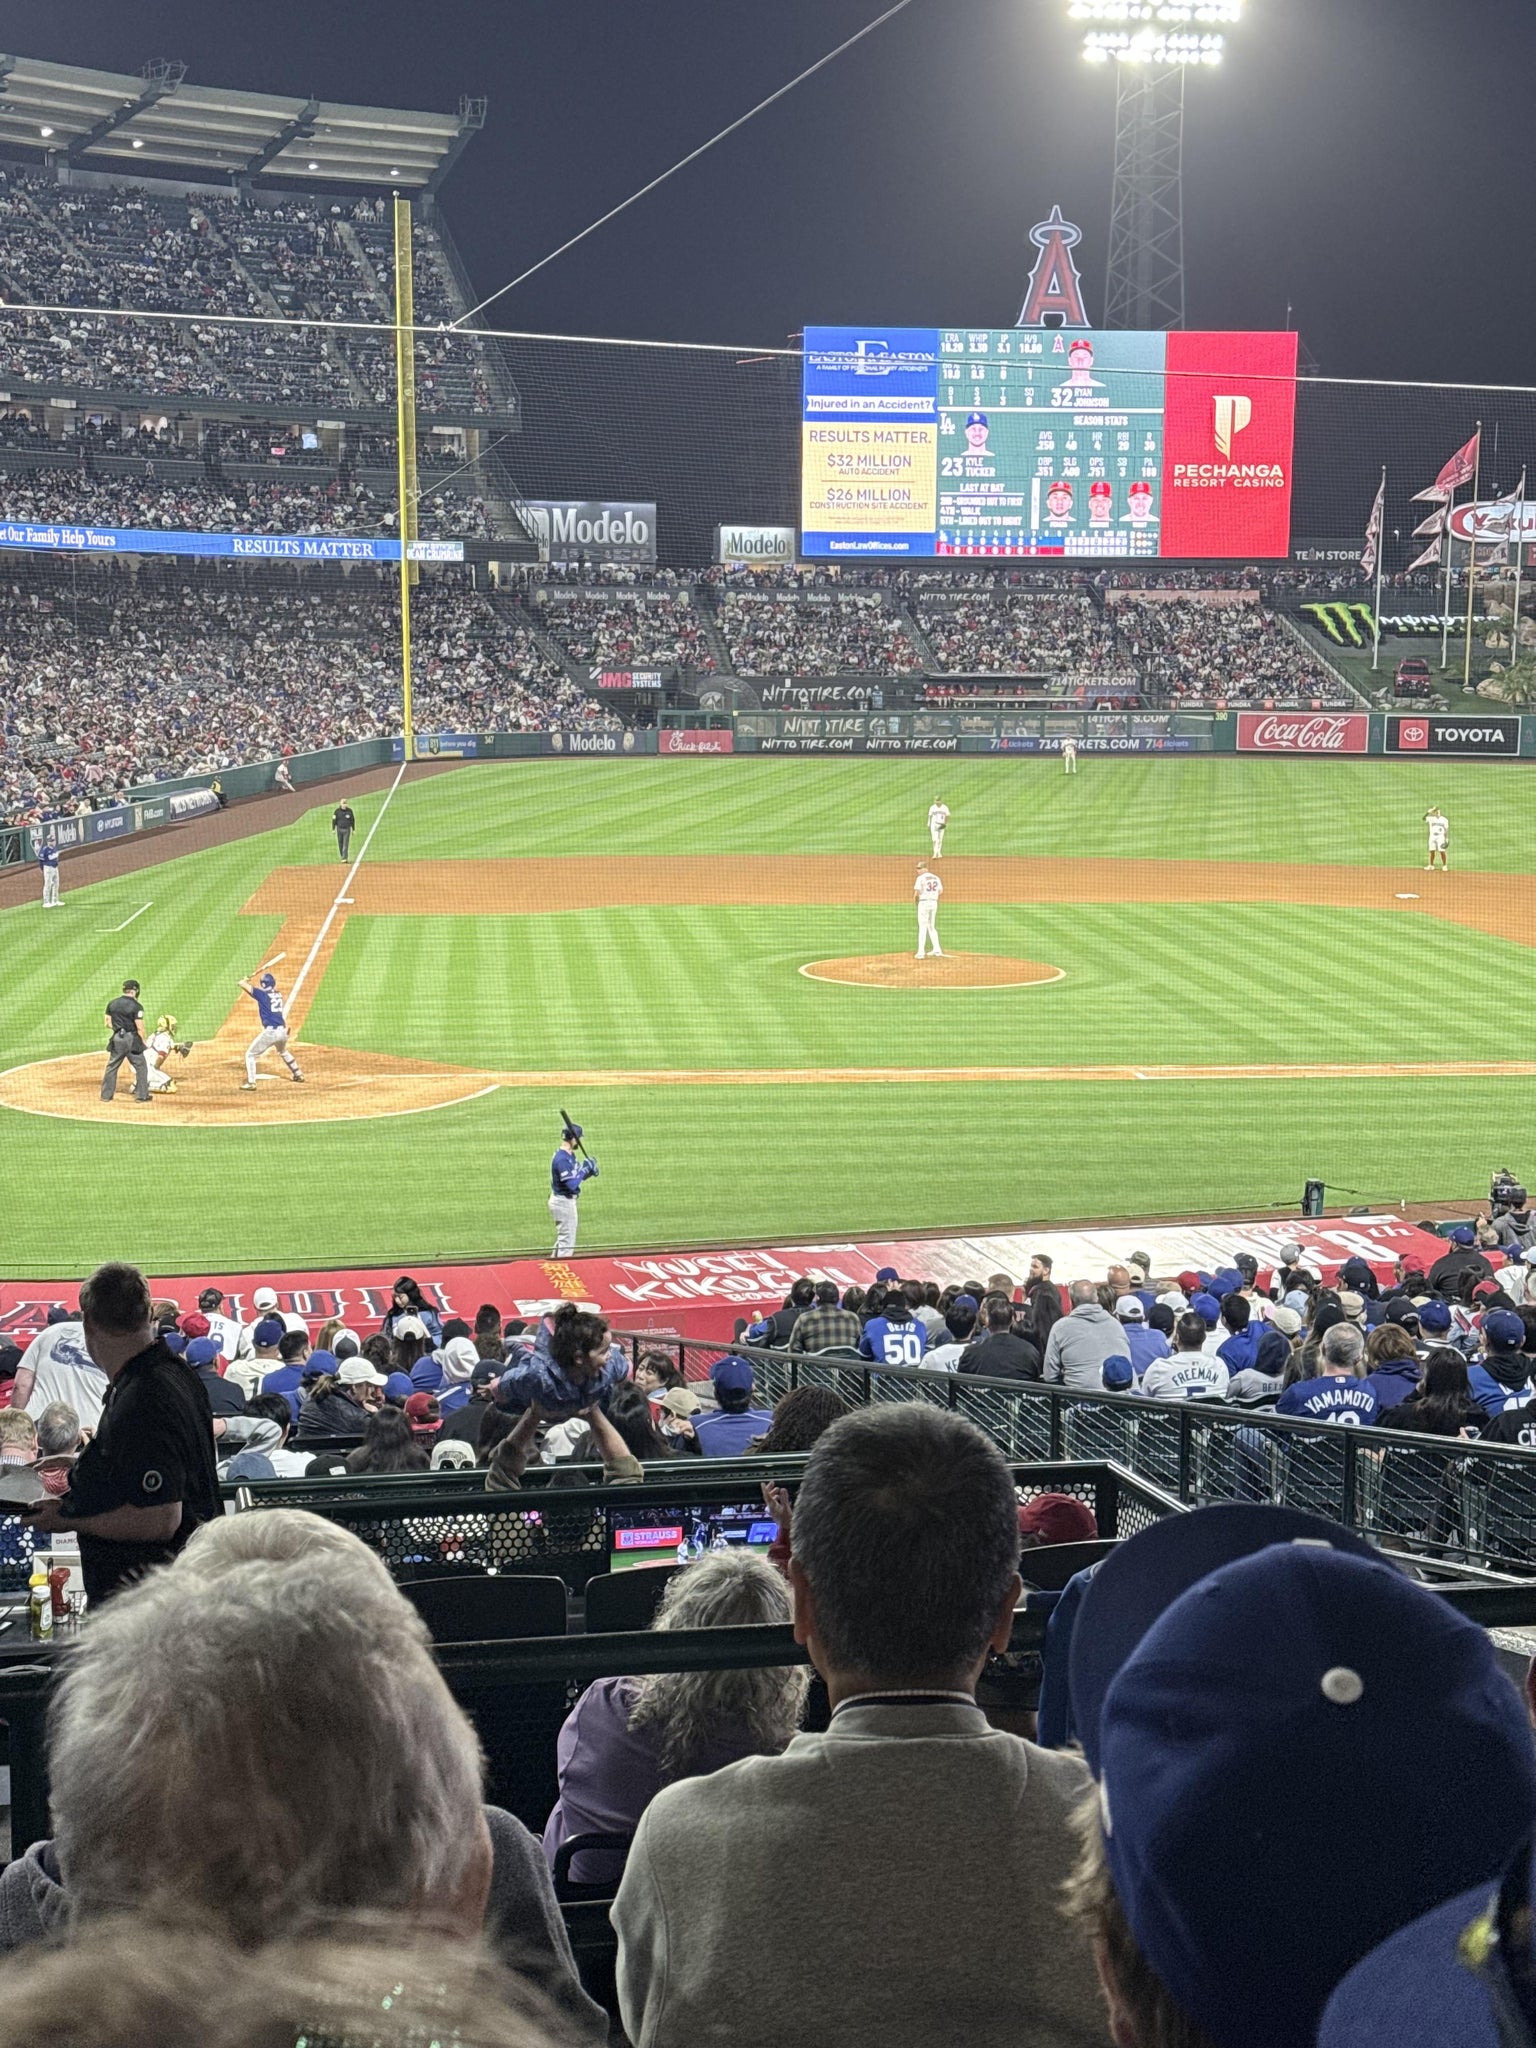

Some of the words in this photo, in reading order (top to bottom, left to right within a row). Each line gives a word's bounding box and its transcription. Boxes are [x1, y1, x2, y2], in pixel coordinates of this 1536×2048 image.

[969, 334, 988, 342] WHIP
[1051, 388, 1072, 407] 32
[1074, 389, 1092, 397] RYAN
[811, 399, 847, 409] Injured
[850, 400, 860, 409] in
[863, 401, 876, 409] an
[878, 400, 931, 410] Accident?
[1105, 416, 1128, 425] STATS
[809, 431, 870, 442] RESULTS
[873, 431, 932, 443] MATTER.
[827, 453, 853, 467] $32
[857, 455, 912, 467] MILLION
[965, 457, 984, 466] KYLE
[941, 457, 963, 476] 23
[965, 467, 995, 477] TUCKER
[1174, 465, 1283, 477] PECHANGA
[1174, 479, 1226, 487] RESORT
[1234, 479, 1284, 487] CASINO
[827, 487, 853, 501] $26
[857, 489, 911, 501] MILLION
[809, 501, 870, 509] CONSTRUCTION
[889, 502, 928, 510] ACCIDENT
[552, 508, 649, 545] Modelo
[8, 527, 25, 541] Our
[26, 528, 60, 546] Family
[62, 529, 85, 547] Help
[87, 531, 115, 546] Yours
[232, 538, 301, 554] RESULTS
[303, 541, 374, 557] MATTER
[731, 532, 786, 554] Modelo
[830, 541, 909, 550] EastonLawOffices.com
[1296, 547, 1325, 561] TEAM
[1327, 551, 1361, 560] STORE
[554, 590, 578, 600] Modelo
[585, 591, 609, 600] Modelo
[646, 591, 670, 601] Modelo
[807, 593, 831, 601] Modelo
[919, 592, 947, 601] NITTO
[632, 672, 661, 680] SECURITY
[1050, 677, 1136, 686] 714TICKETS.COM
[632, 680, 661, 688] SYSTEMS
[1216, 712, 1228, 721] 390
[1254, 716, 1351, 748] Coca-Cola
[1435, 728, 1505, 742] TOYOTA
[484, 736, 495, 744] 347
[570, 734, 616, 752] Modelo
[762, 738, 797, 749] NITTO
[800, 738, 853, 749] TIRE.COM
[866, 738, 901, 749] NITTO
[904, 738, 957, 749] TIRE.COM
[58, 823, 77, 844] Modelo
[926, 881, 938, 892] 32
[1366, 1225, 1414, 1238] th
[613, 1251, 790, 1280] YUSEI
[883, 1334, 921, 1365] 50
[1171, 1367, 1218, 1388] FREEMAN
[1304, 1389, 1375, 1414] YAMAMOTO
[634, 1530, 678, 1541] STRAUSS
